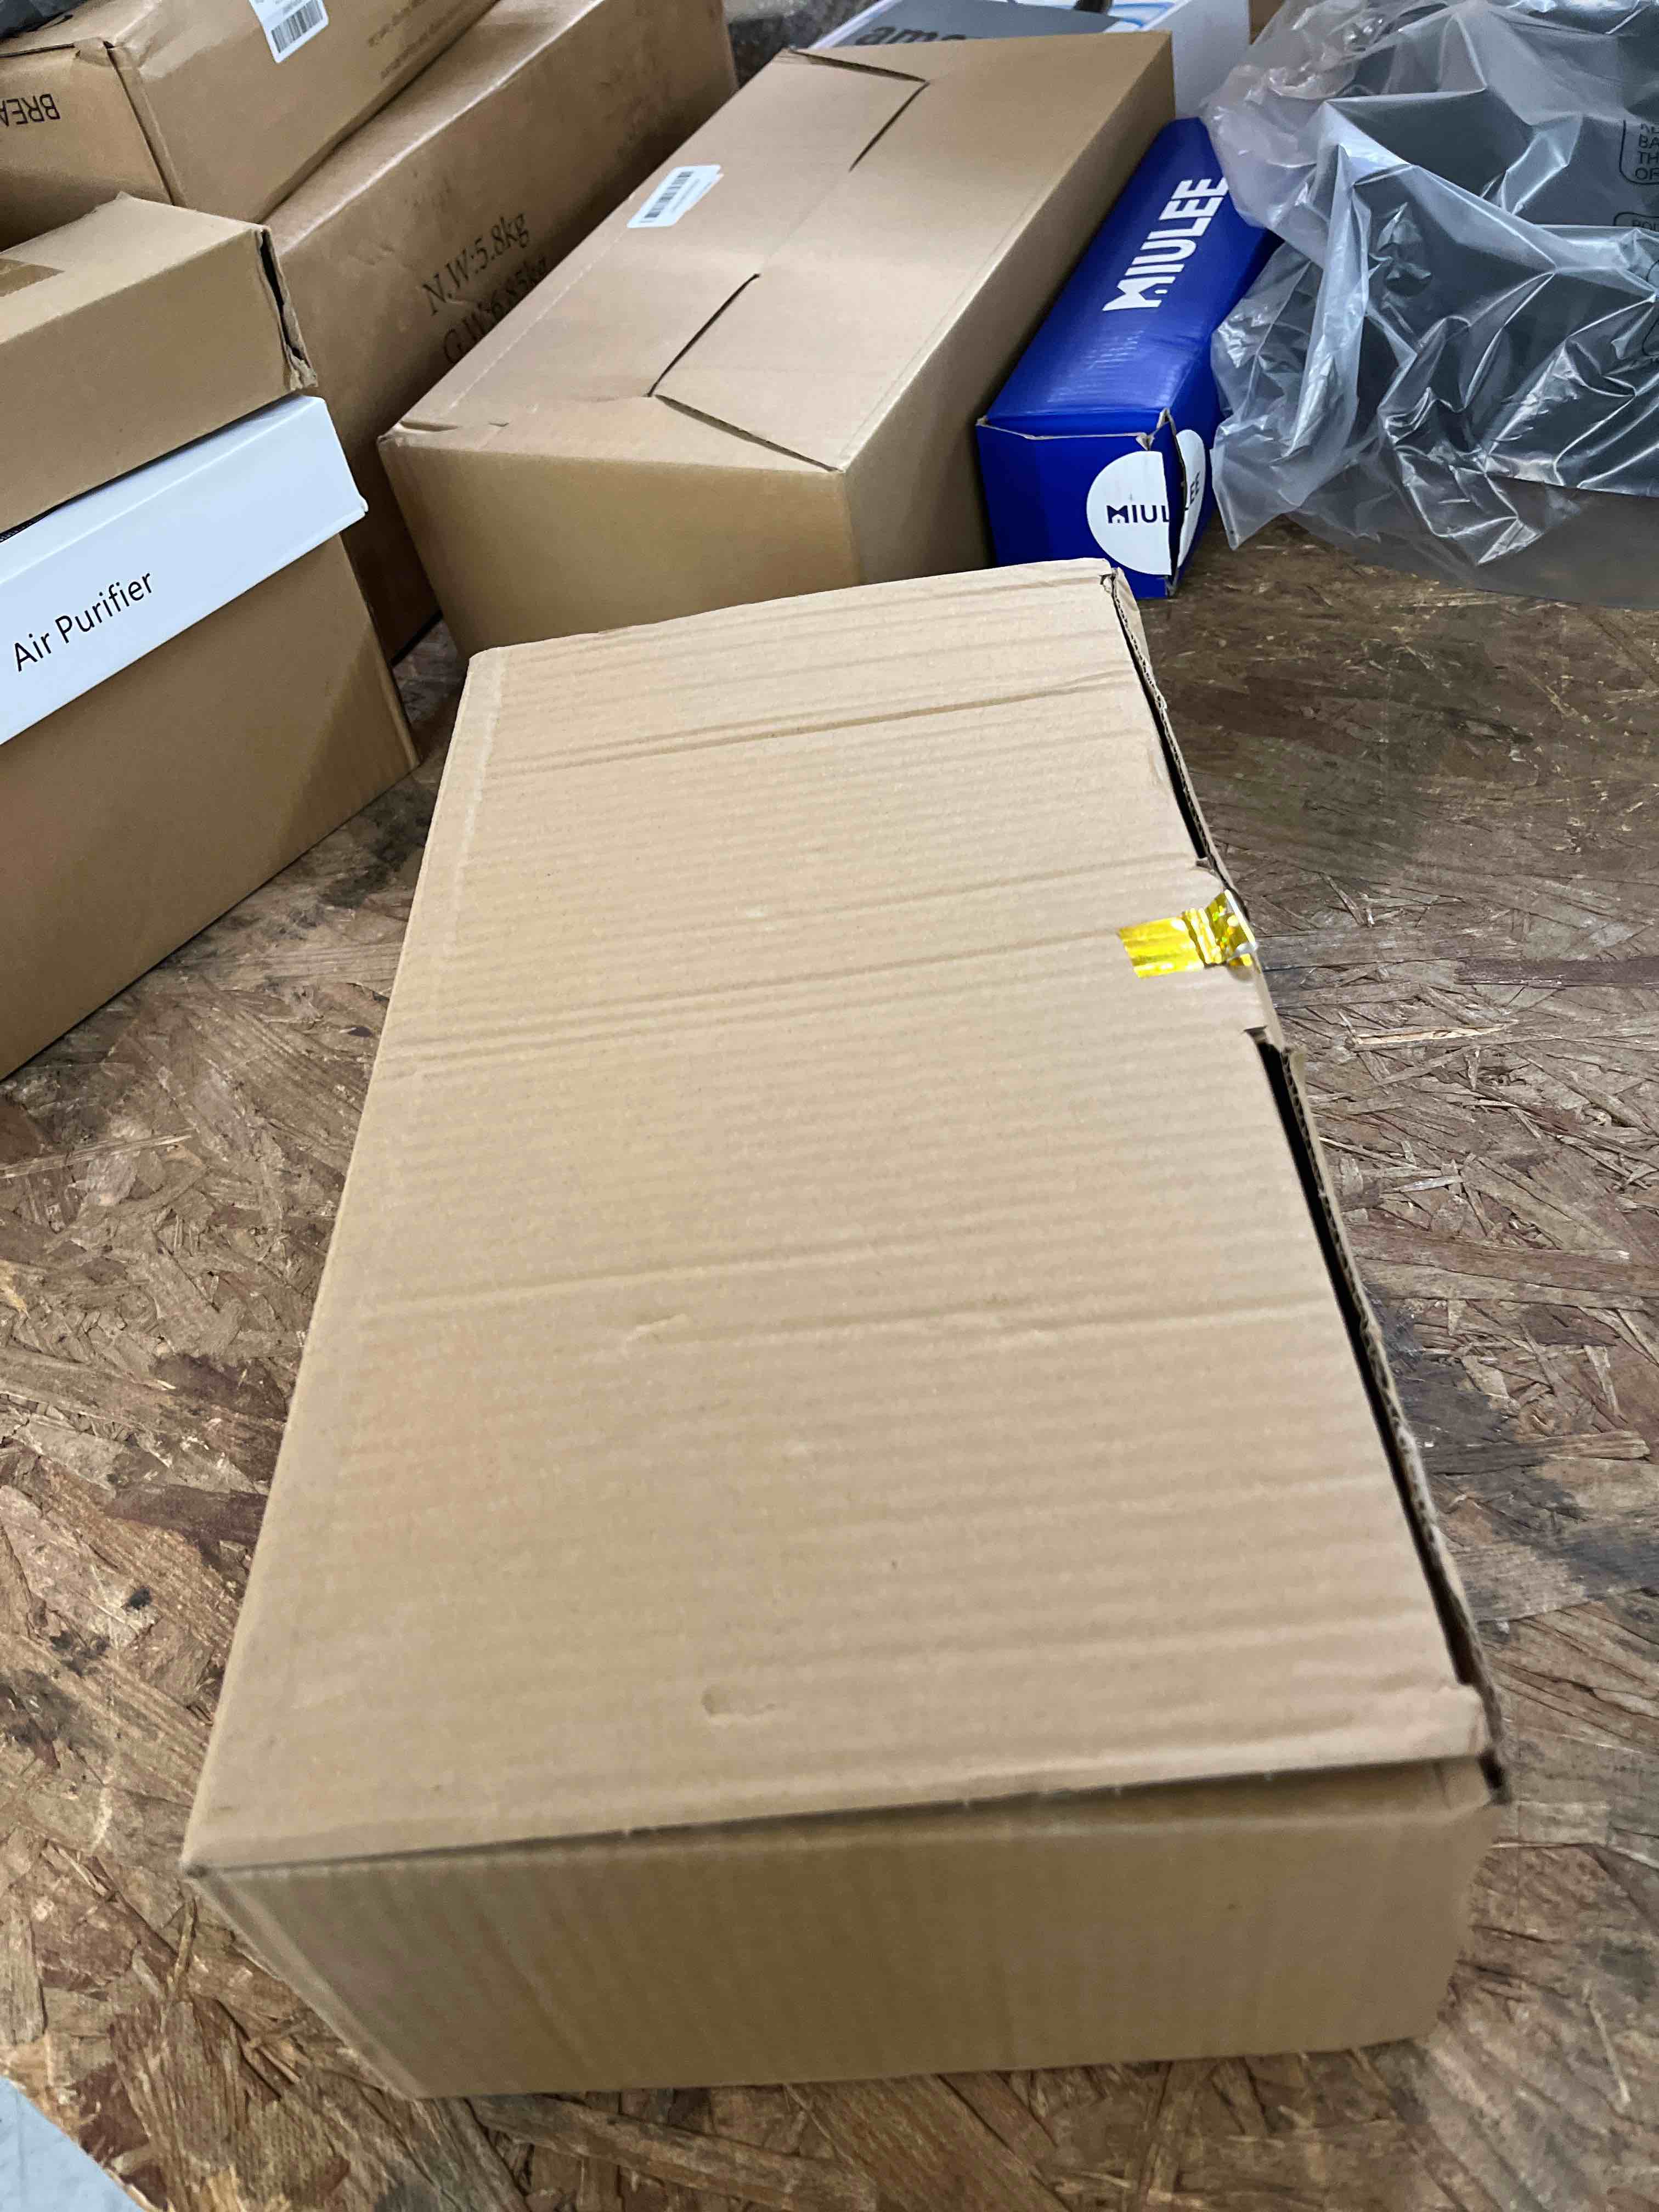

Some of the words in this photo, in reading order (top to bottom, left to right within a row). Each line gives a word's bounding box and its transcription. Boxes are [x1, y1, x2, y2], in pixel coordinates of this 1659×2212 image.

[1102, 176, 1229, 312] MIULEE
[14, 633, 52, 672] Air
[55, 573, 152, 644] Purifier
